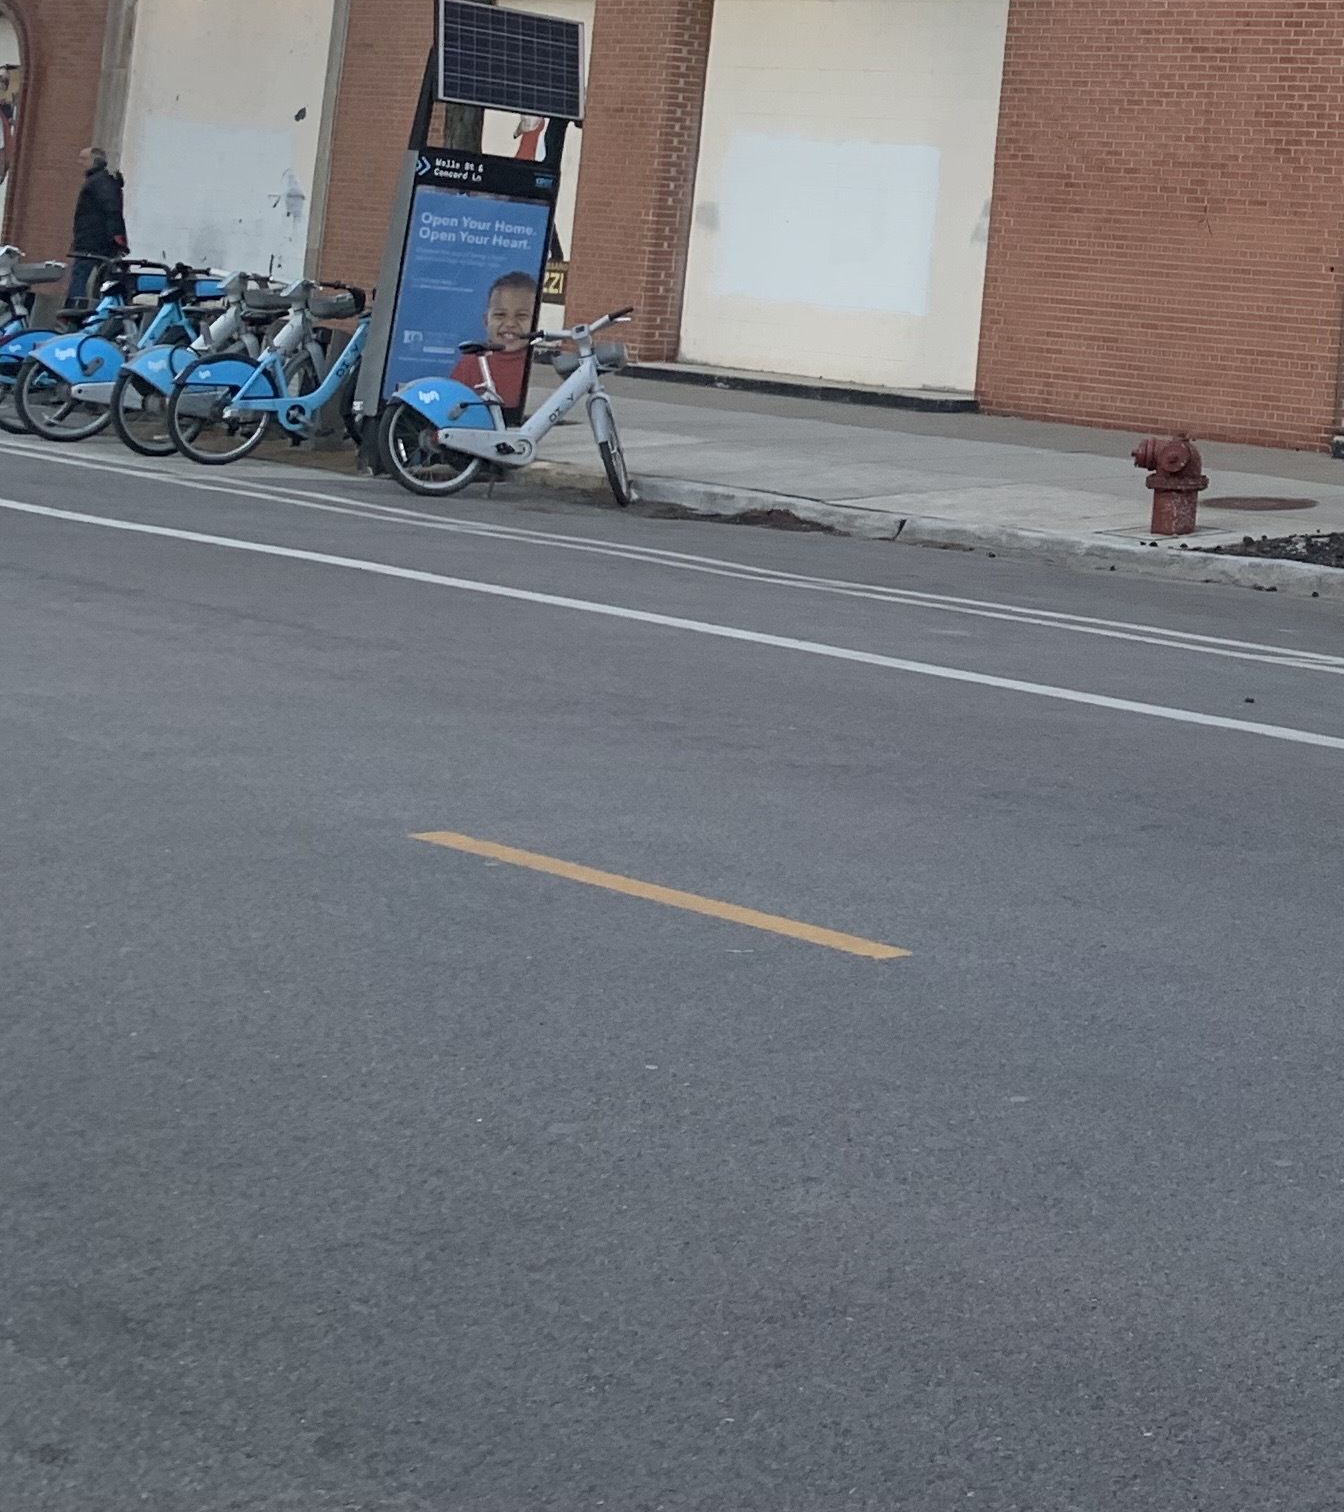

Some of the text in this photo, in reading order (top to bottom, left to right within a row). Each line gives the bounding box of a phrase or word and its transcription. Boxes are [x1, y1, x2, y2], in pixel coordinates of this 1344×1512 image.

[435, 158, 460, 169] Wells
[464, 161, 475, 171] St
[434, 168, 482, 182] Concord Ln
[421, 212, 537, 236] Open Your Home.
[419, 227, 531, 250] Open Your Heart.
[418, 390, 440, 404] lyft
